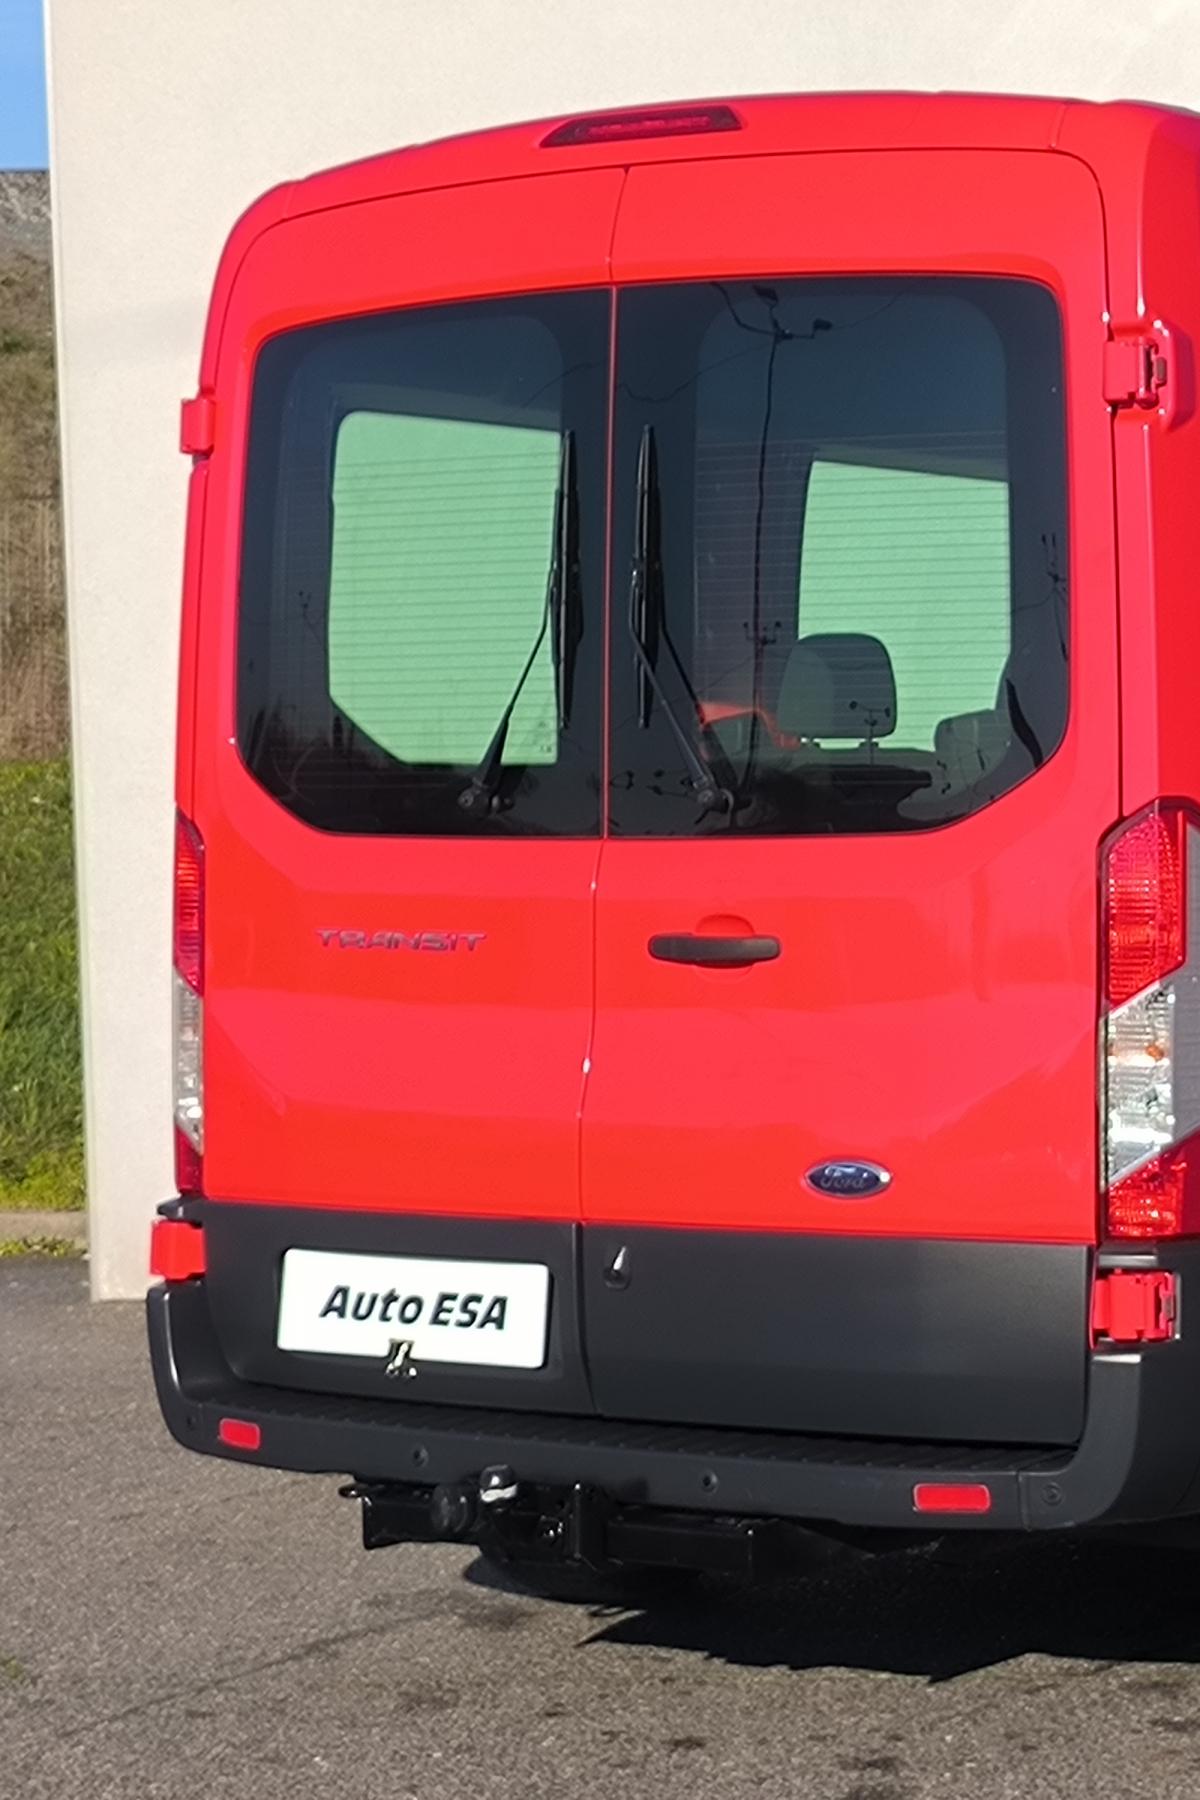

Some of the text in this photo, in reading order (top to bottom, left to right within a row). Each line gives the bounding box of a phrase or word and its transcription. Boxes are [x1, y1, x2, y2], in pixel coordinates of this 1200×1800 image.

[316, 929, 487, 951] TRANSIT
[820, 1165, 868, 1189] Ford
[319, 1285, 508, 1330] Auto ESA
